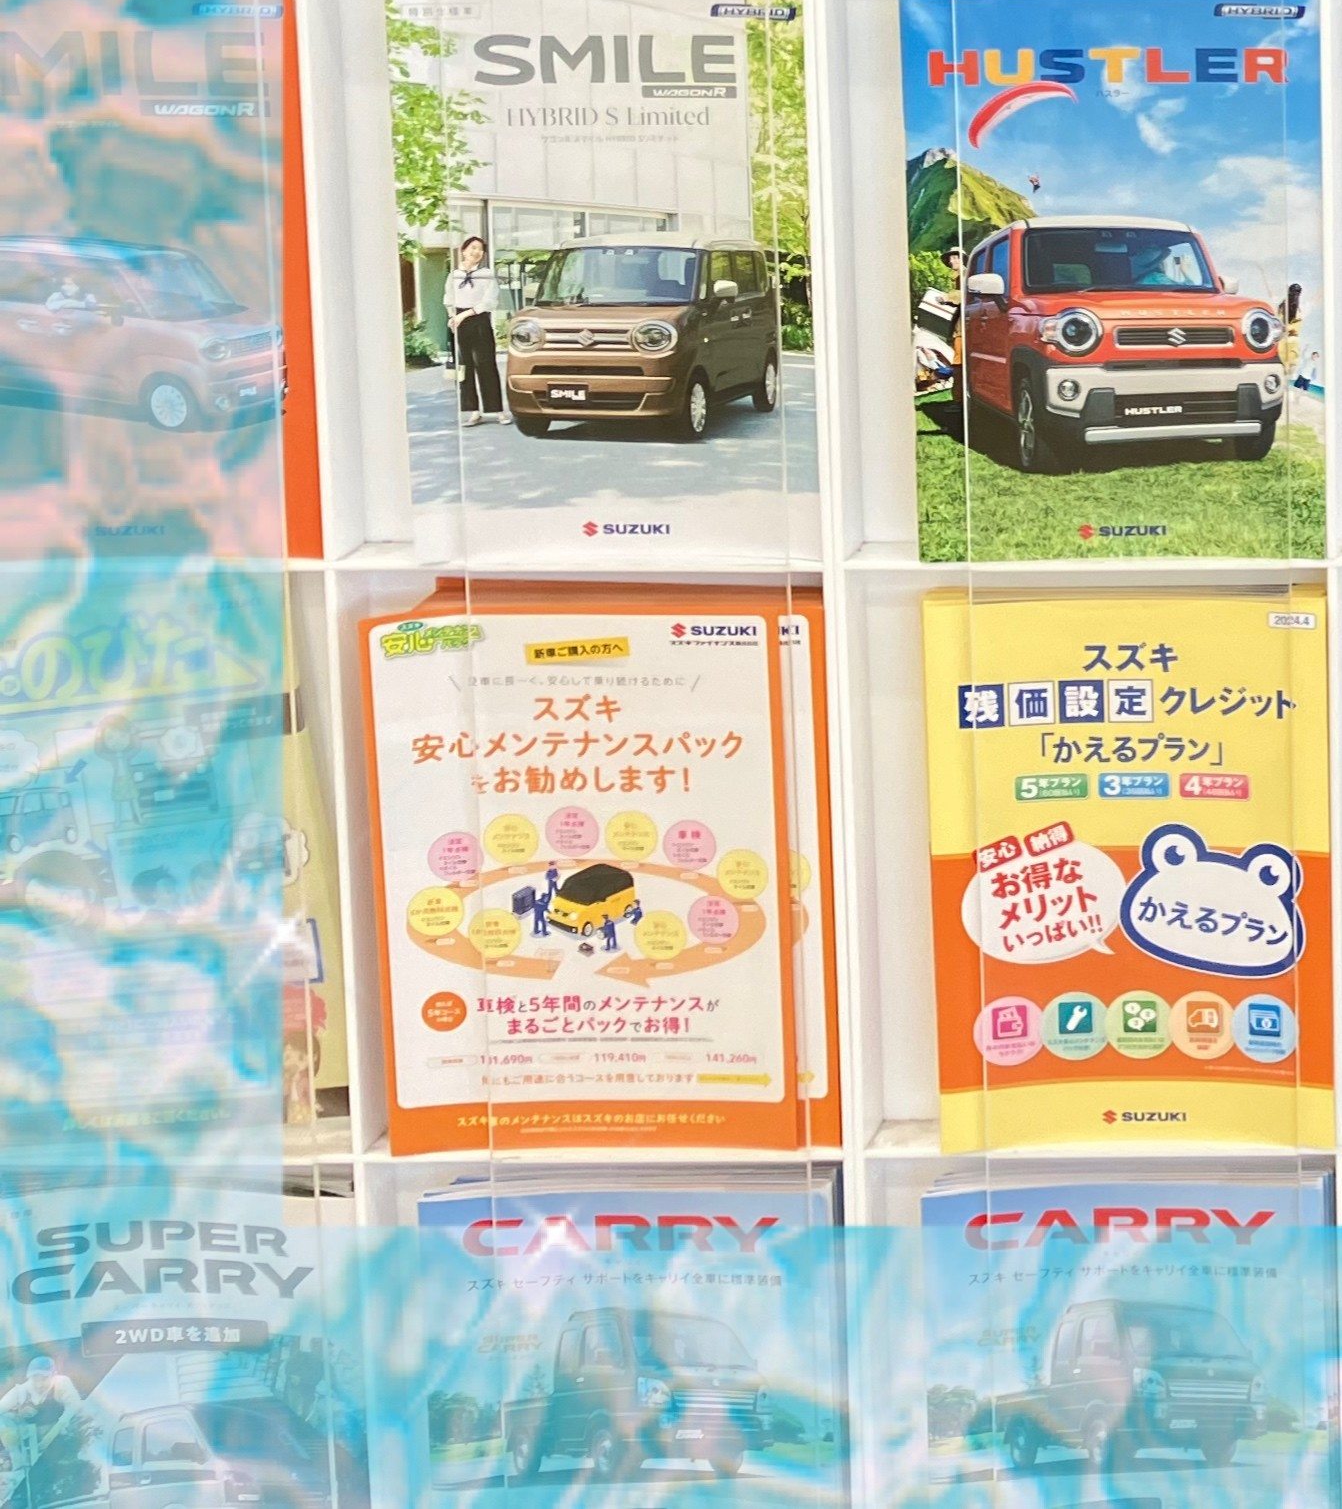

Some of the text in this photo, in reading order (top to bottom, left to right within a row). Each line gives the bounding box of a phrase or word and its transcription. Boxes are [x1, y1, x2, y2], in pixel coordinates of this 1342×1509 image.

[1226, 5, 1293, 18] HYBRID
[473, 33, 737, 86] SMILE
[927, 45, 1291, 88] HUSTLER
[506, 105, 711, 128] HYBRID S Limited
[549, 388, 588, 401] SMILE
[1124, 404, 1183, 415] HUSTLER
[601, 522, 672, 536] SUZUKI
[1097, 525, 1168, 538] SUZUKI
[689, 624, 758, 637] SUZUKI
[1081, 642, 1179, 673] スズキ
[532, 693, 623, 724] スズキ
[411, 729, 745, 765] 安心メンテナンスパック
[1039, 731, 1224, 767] 「かえるプラン」
[977, 840, 1021, 869] 安心
[990, 857, 1083, 900] お得な
[998, 884, 1099, 932] メリット
[1137, 895, 1290, 947] かえるプラン
[505, 1015, 691, 1037] まるごとパックでお得！
[1121, 1111, 1188, 1123] SUZUKI
[36, 1219, 289, 1260] SUPER
[461, 1214, 781, 1258] CARRY
[963, 1205, 1277, 1253] CARRY
[8, 1256, 316, 1306] CARRY
